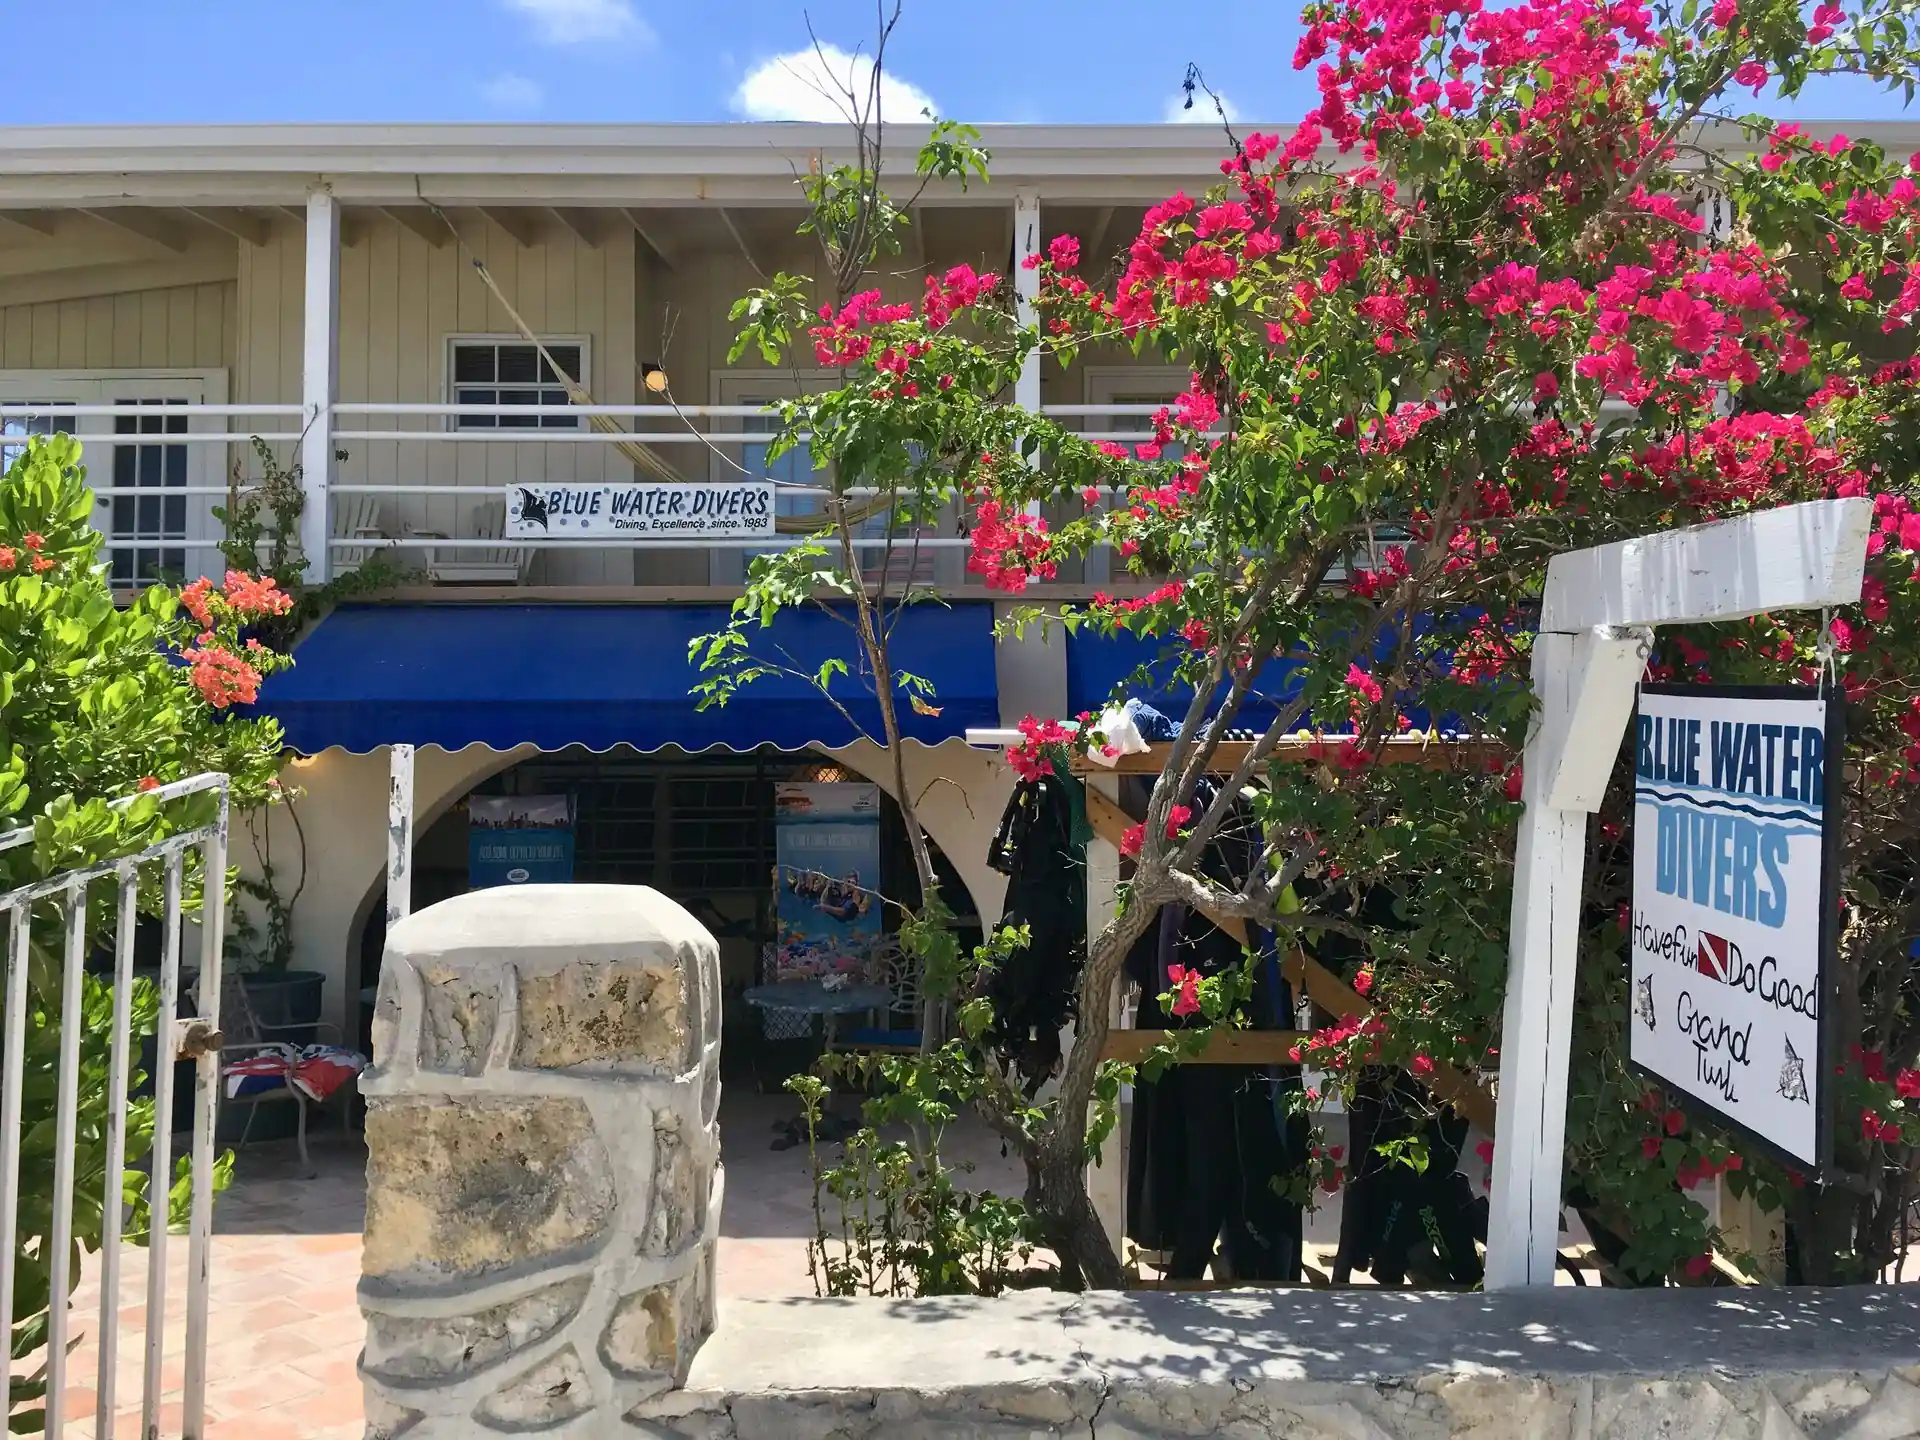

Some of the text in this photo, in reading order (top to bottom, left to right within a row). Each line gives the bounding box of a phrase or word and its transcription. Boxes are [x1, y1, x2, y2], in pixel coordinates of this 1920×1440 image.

[548, 490, 769, 515] BLUE WATER DIVERS
[615, 518, 767, 530] Diving Excellence since 1983
[1636, 714, 1825, 805] BLUE WATER
[1656, 806, 1789, 929] DIVERS
[1678, 991, 1752, 1066] Grand
